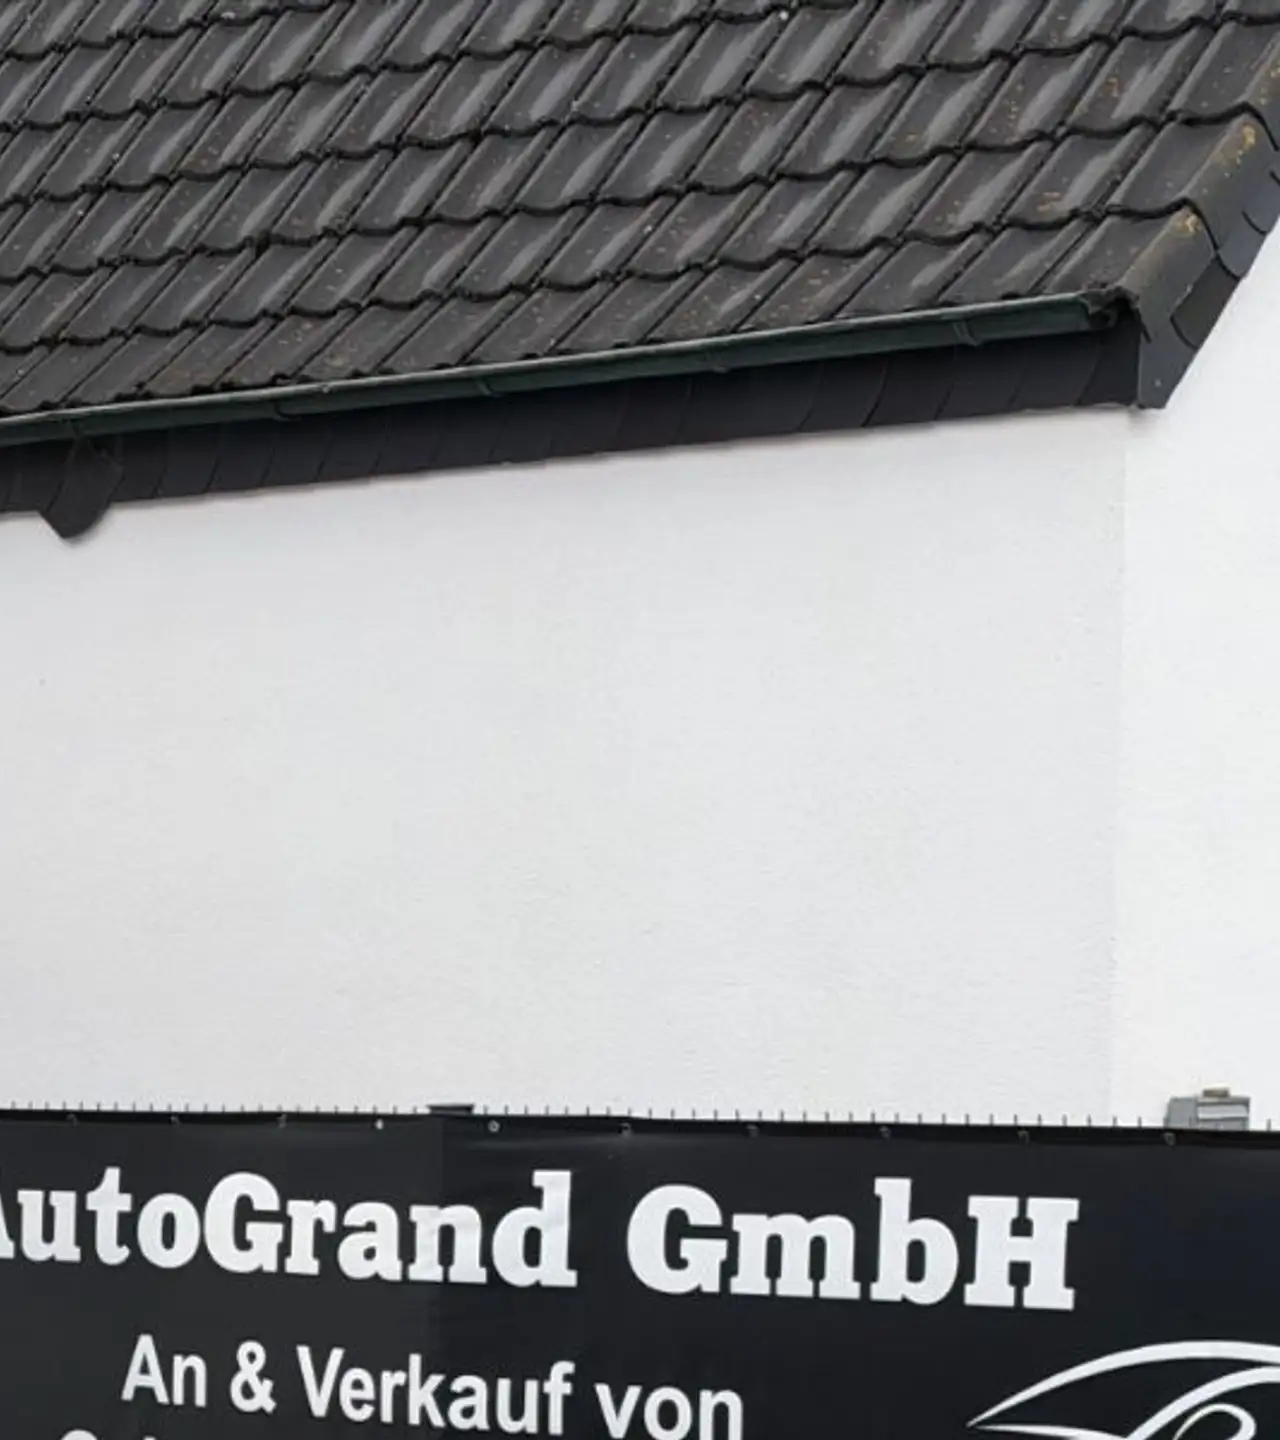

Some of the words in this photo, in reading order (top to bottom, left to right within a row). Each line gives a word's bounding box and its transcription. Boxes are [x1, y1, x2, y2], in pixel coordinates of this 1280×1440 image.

[626, 1177, 1080, 1311] GmbH
[121, 1334, 207, 1408] An
[230, 1340, 277, 1413] &
[296, 1345, 576, 1436] Verkauf
